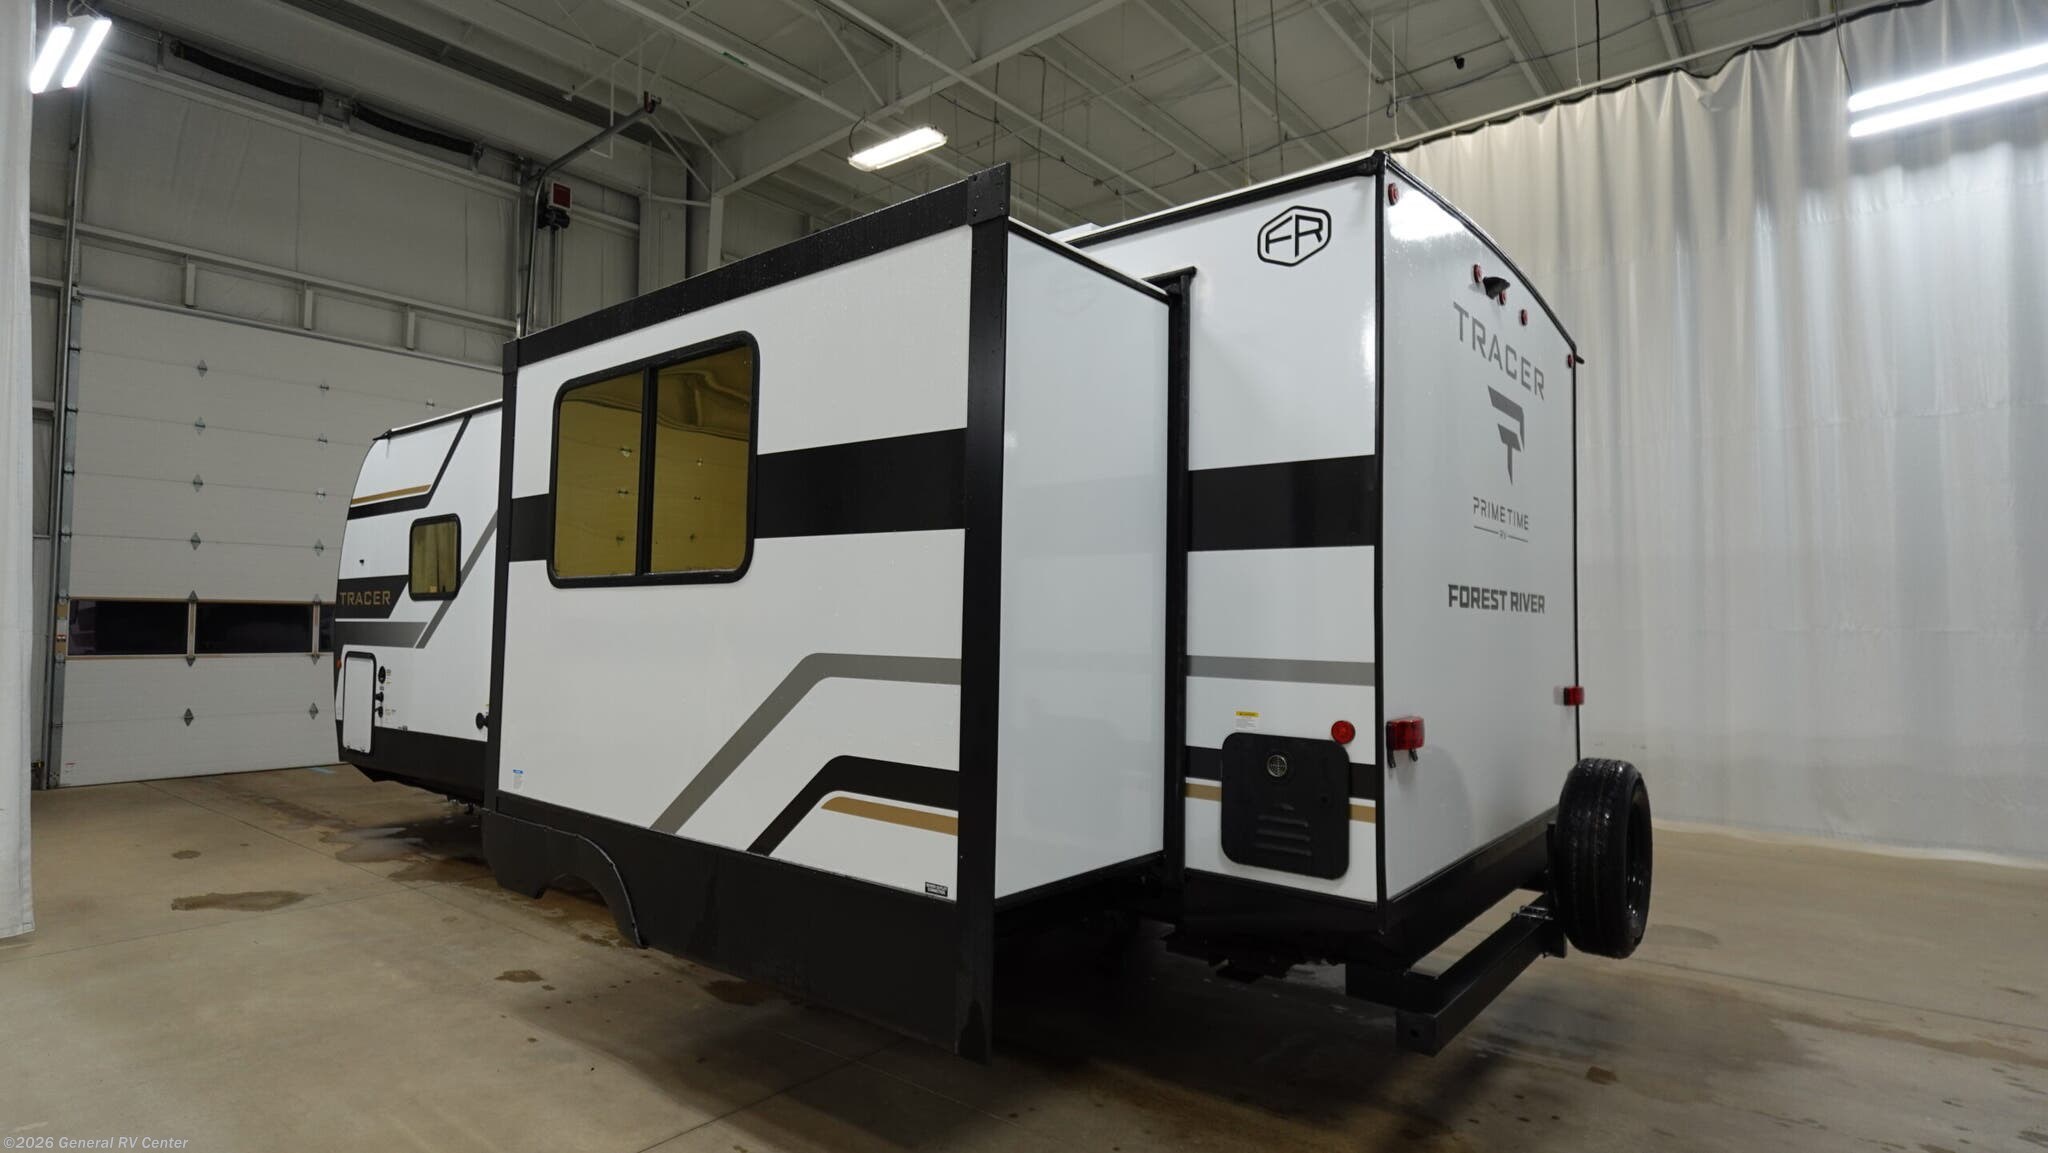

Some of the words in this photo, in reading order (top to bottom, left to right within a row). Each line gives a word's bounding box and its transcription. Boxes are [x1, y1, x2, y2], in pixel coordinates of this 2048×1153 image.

[1453, 301, 1545, 401] TRACER
[339, 590, 391, 606] TRACER
[1448, 584, 1508, 612] FOREST
[1510, 591, 1545, 614] RIVER
